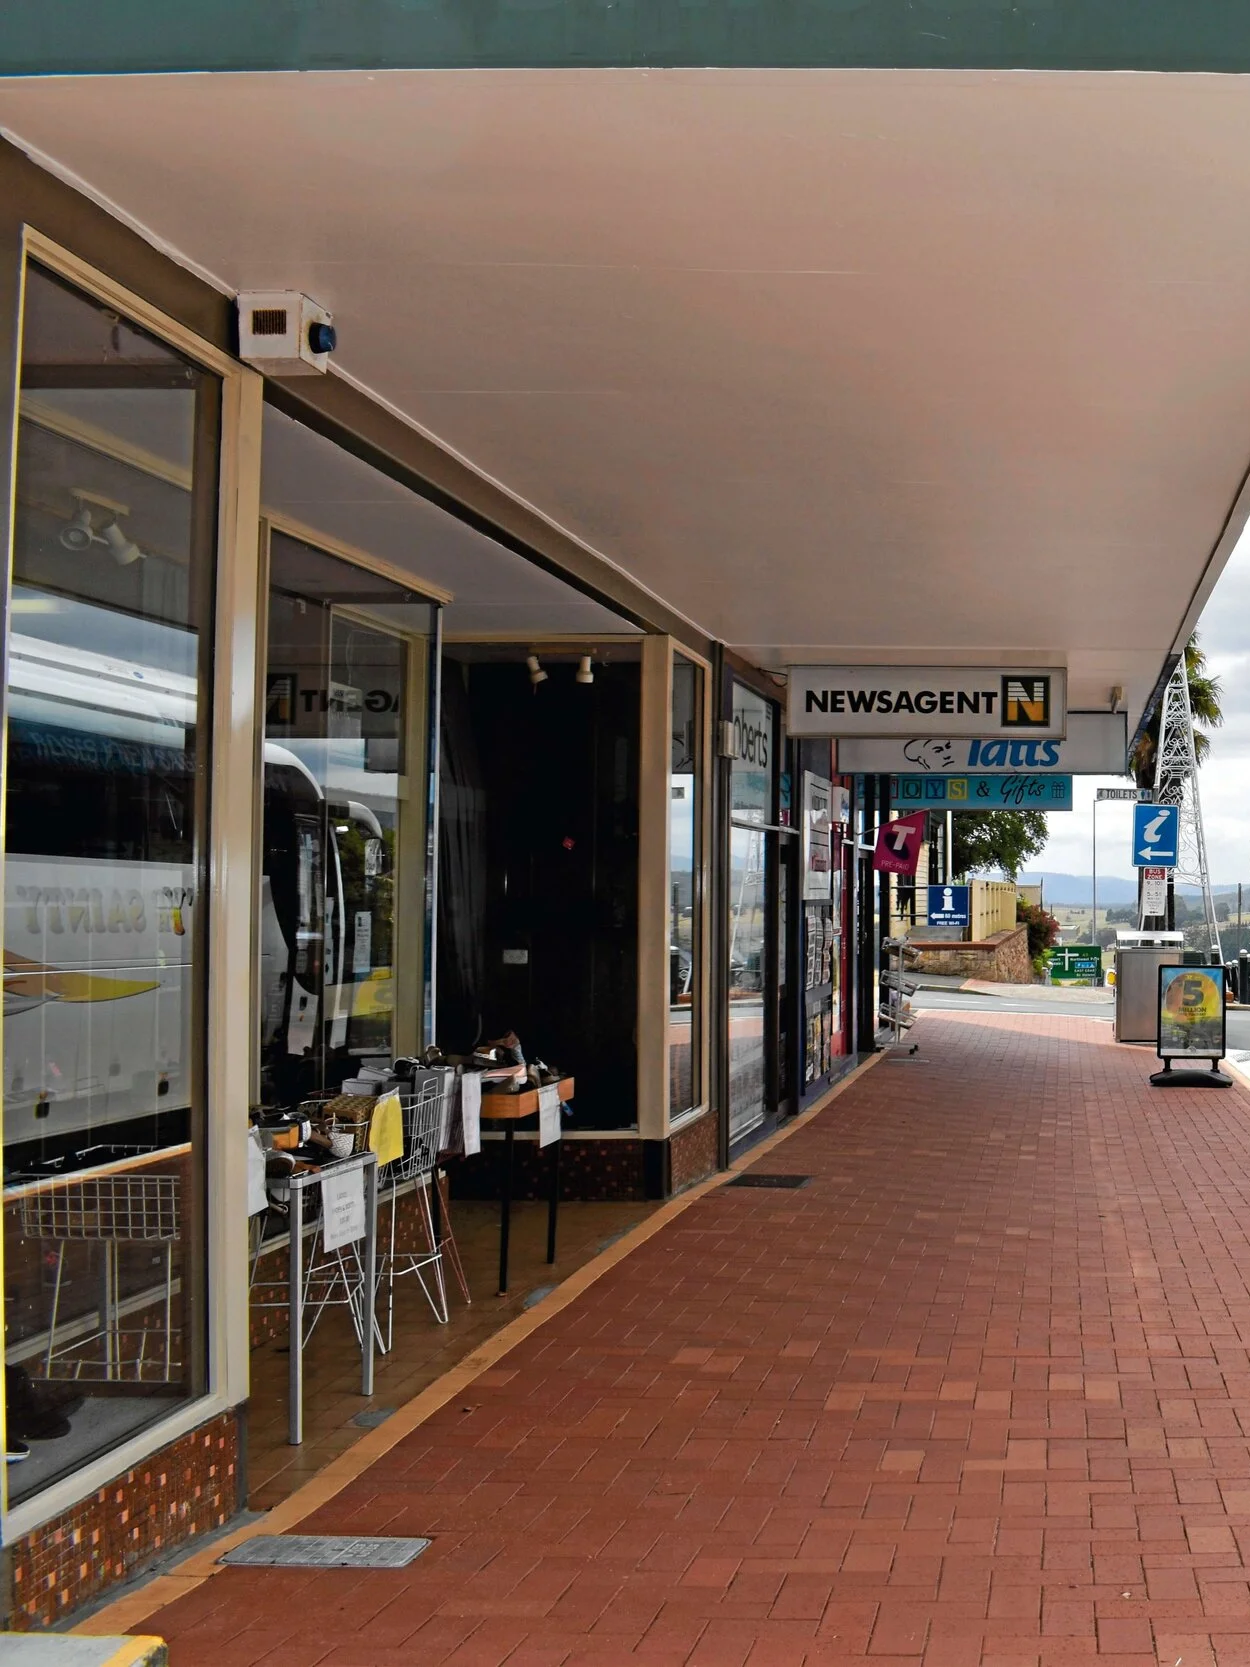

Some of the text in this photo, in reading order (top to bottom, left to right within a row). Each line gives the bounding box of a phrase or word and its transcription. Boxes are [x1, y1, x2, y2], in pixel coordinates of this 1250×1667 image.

[805, 690, 998, 714] NEWSAGENT
[891, 775, 1045, 804] OYS & Gifts
[1107, 789, 1137, 799] TOILETS
[892, 825, 916, 850] T
[881, 860, 909, 870] PRE-PAID
[1183, 980, 1204, 1006] 5
